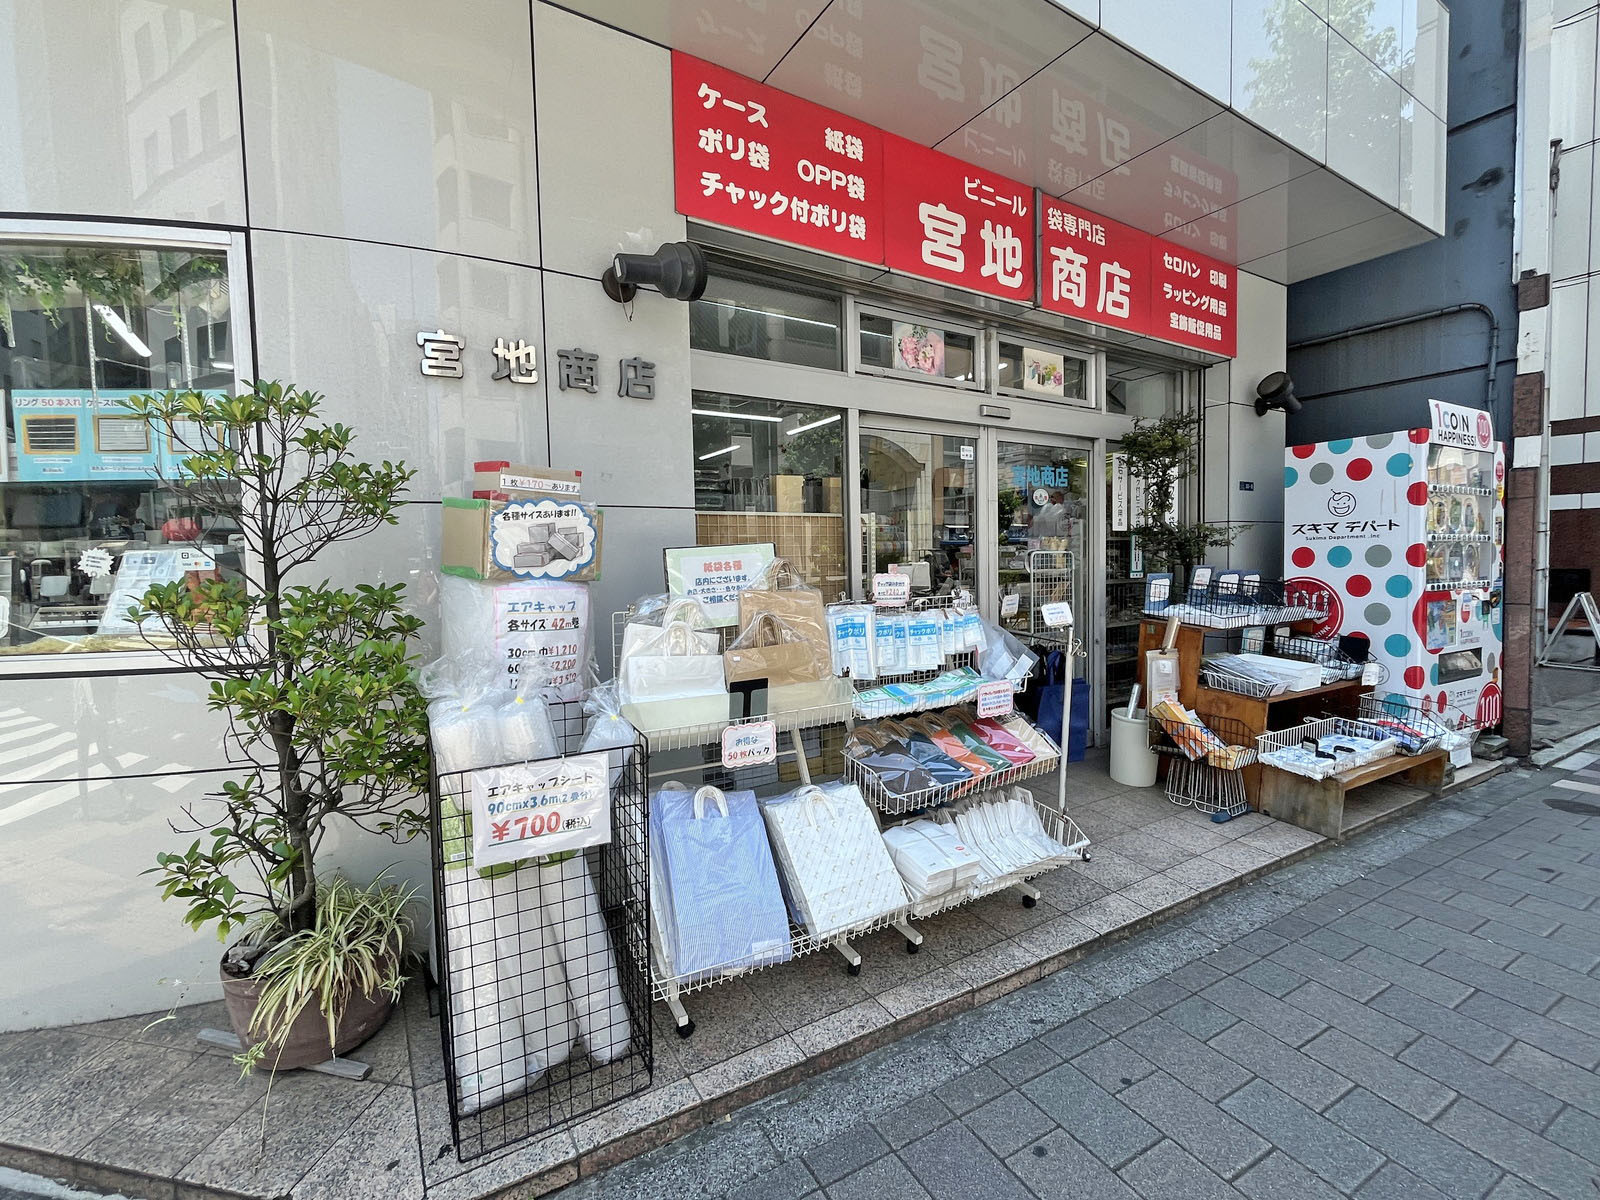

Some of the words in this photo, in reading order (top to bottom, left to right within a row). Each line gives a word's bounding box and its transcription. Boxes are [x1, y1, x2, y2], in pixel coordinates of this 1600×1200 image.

[698, 83, 769, 128] ケース
[698, 127, 770, 171] ポリ袋
[824, 127, 863, 162] 紙袋
[797, 159, 865, 201] OPP袋
[700, 171, 866, 240] チャック付ポリ袋
[1163, 252, 1201, 278] セロハン
[1163, 282, 1227, 317] ラッピング用品
[15, 399, 38, 407] リング
[41, 399, 54, 407] 50
[56, 399, 81, 407] 本入れ
[1292, 521, 1339, 535] スキマ
[1345, 519, 1400, 533] デパート
[1481, 693, 1500, 721] 100
[491, 811, 561, 841] ¥700
